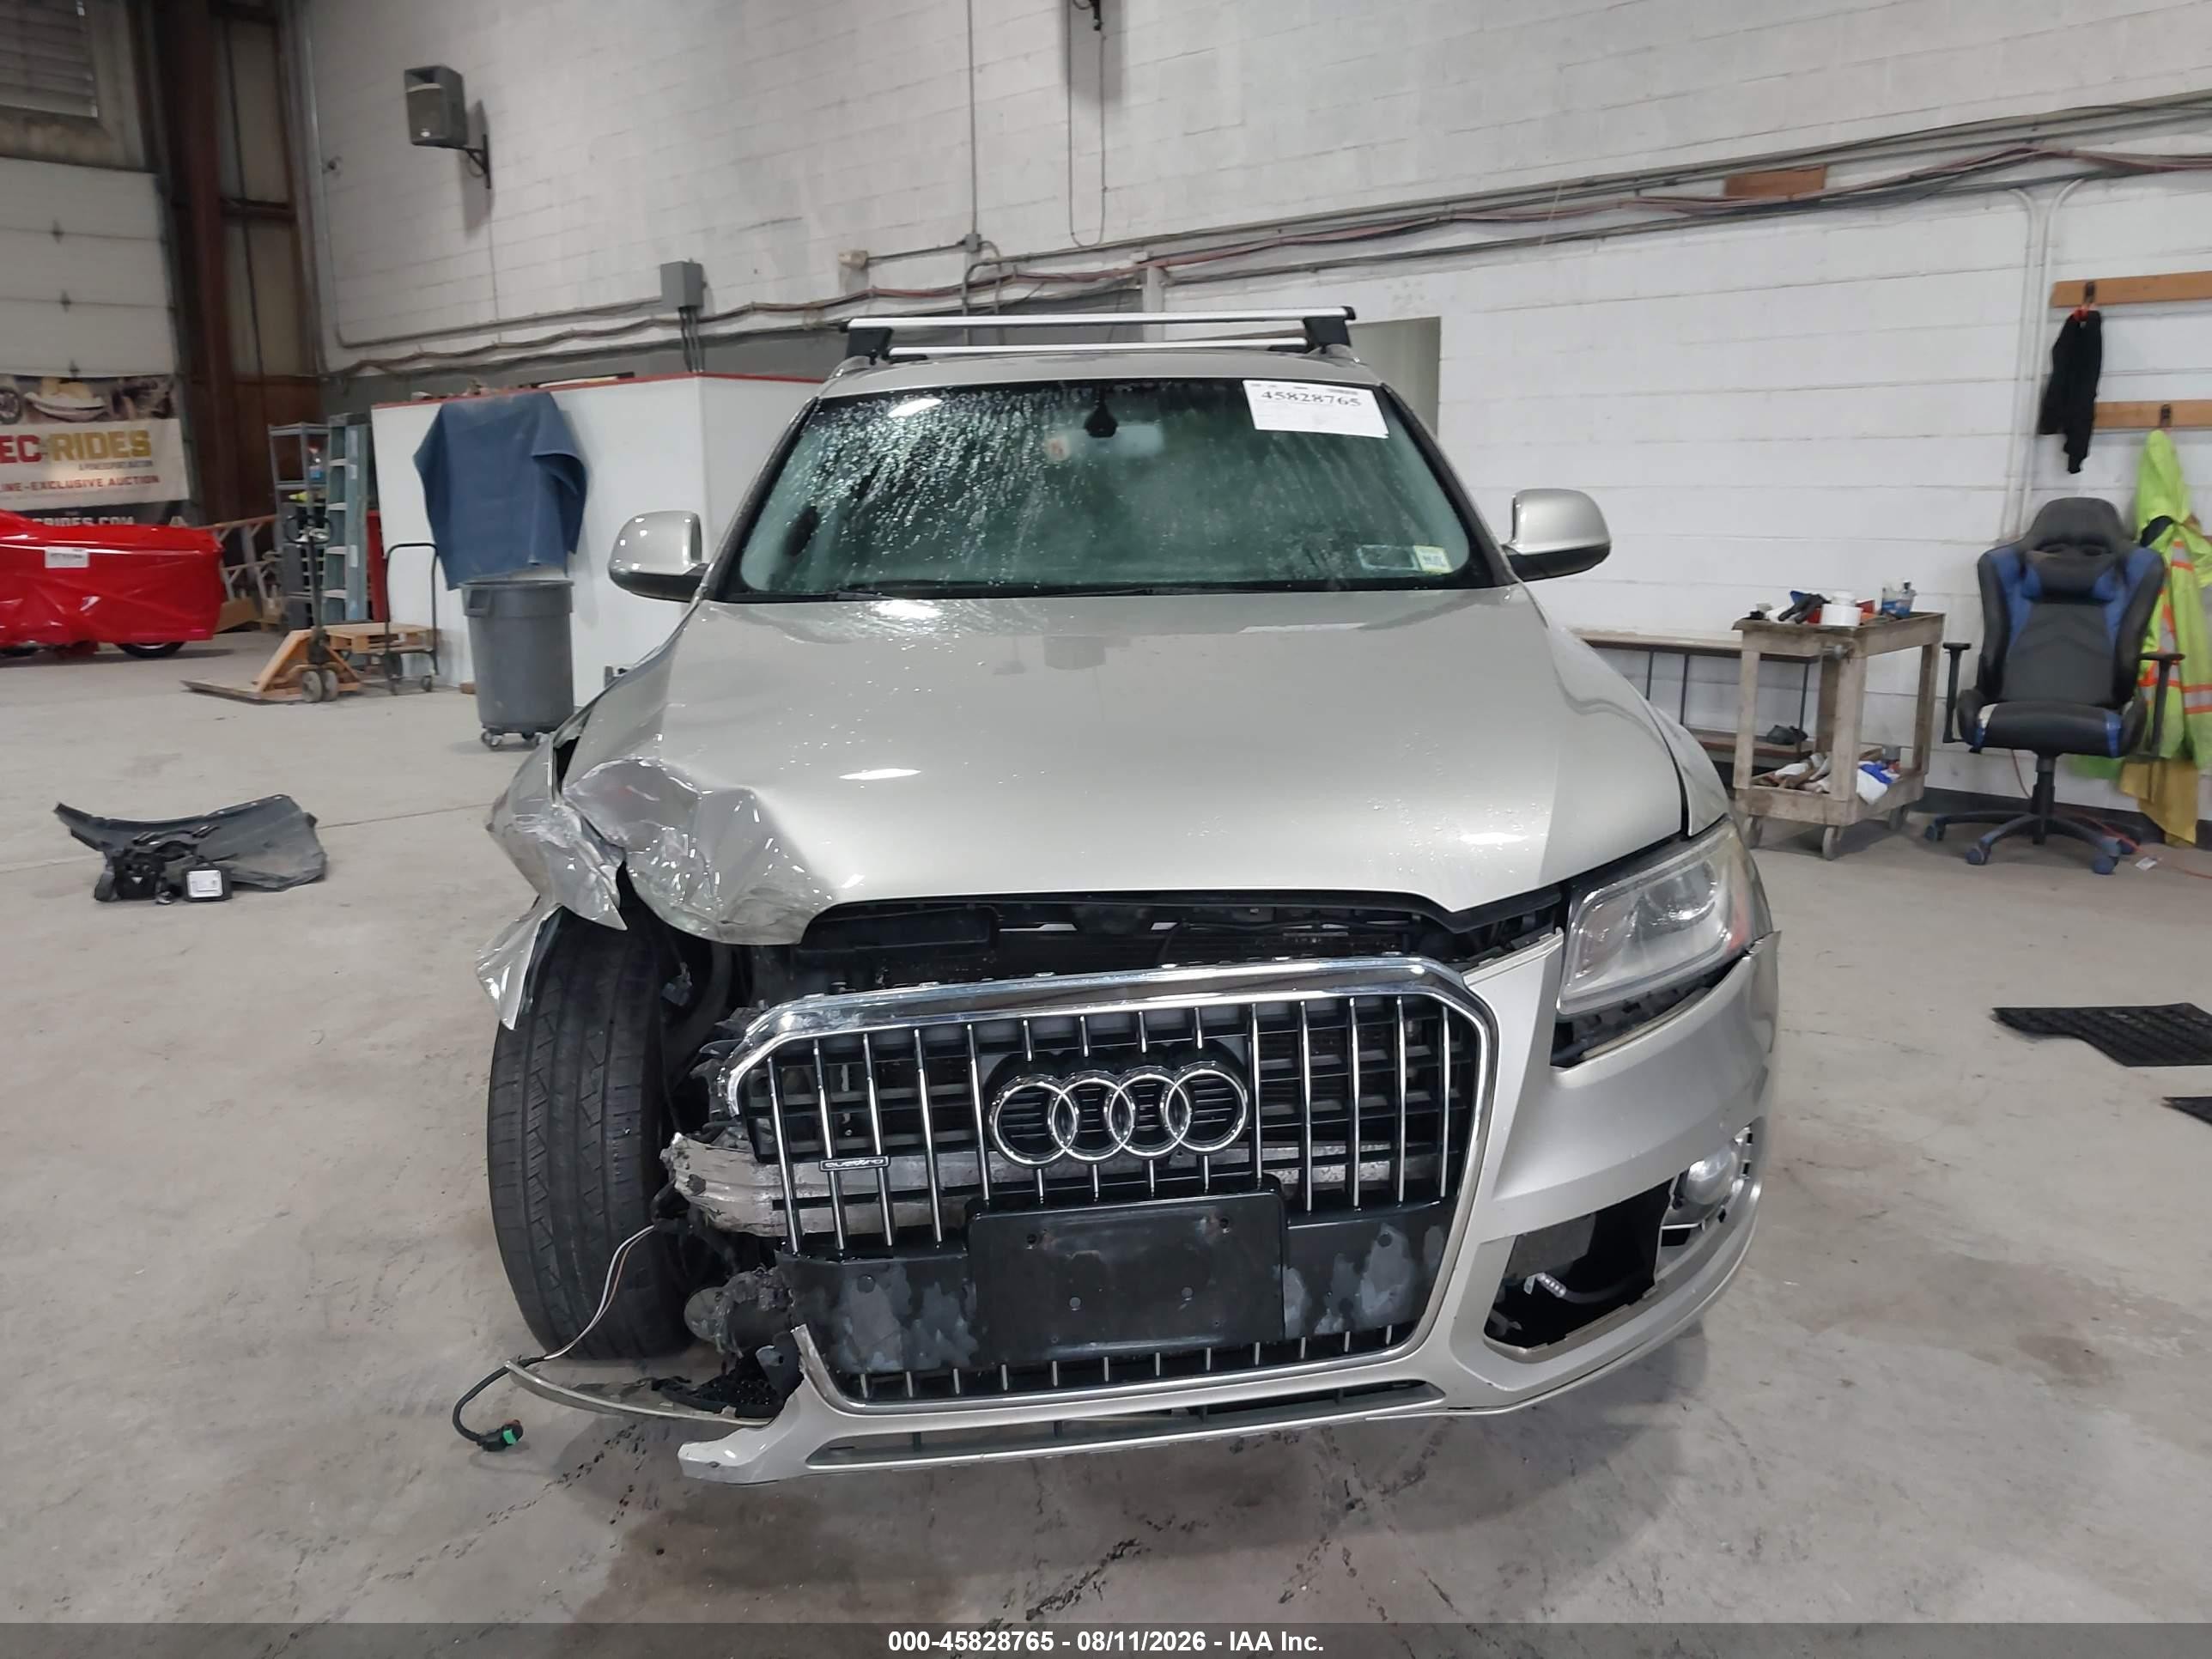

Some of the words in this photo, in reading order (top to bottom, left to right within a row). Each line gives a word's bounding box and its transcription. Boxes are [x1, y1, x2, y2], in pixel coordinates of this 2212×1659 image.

[1261, 391, 1362, 407] 45828765
[50, 430, 152, 461] RIDES
[108, 475, 160, 487] AUCTION
